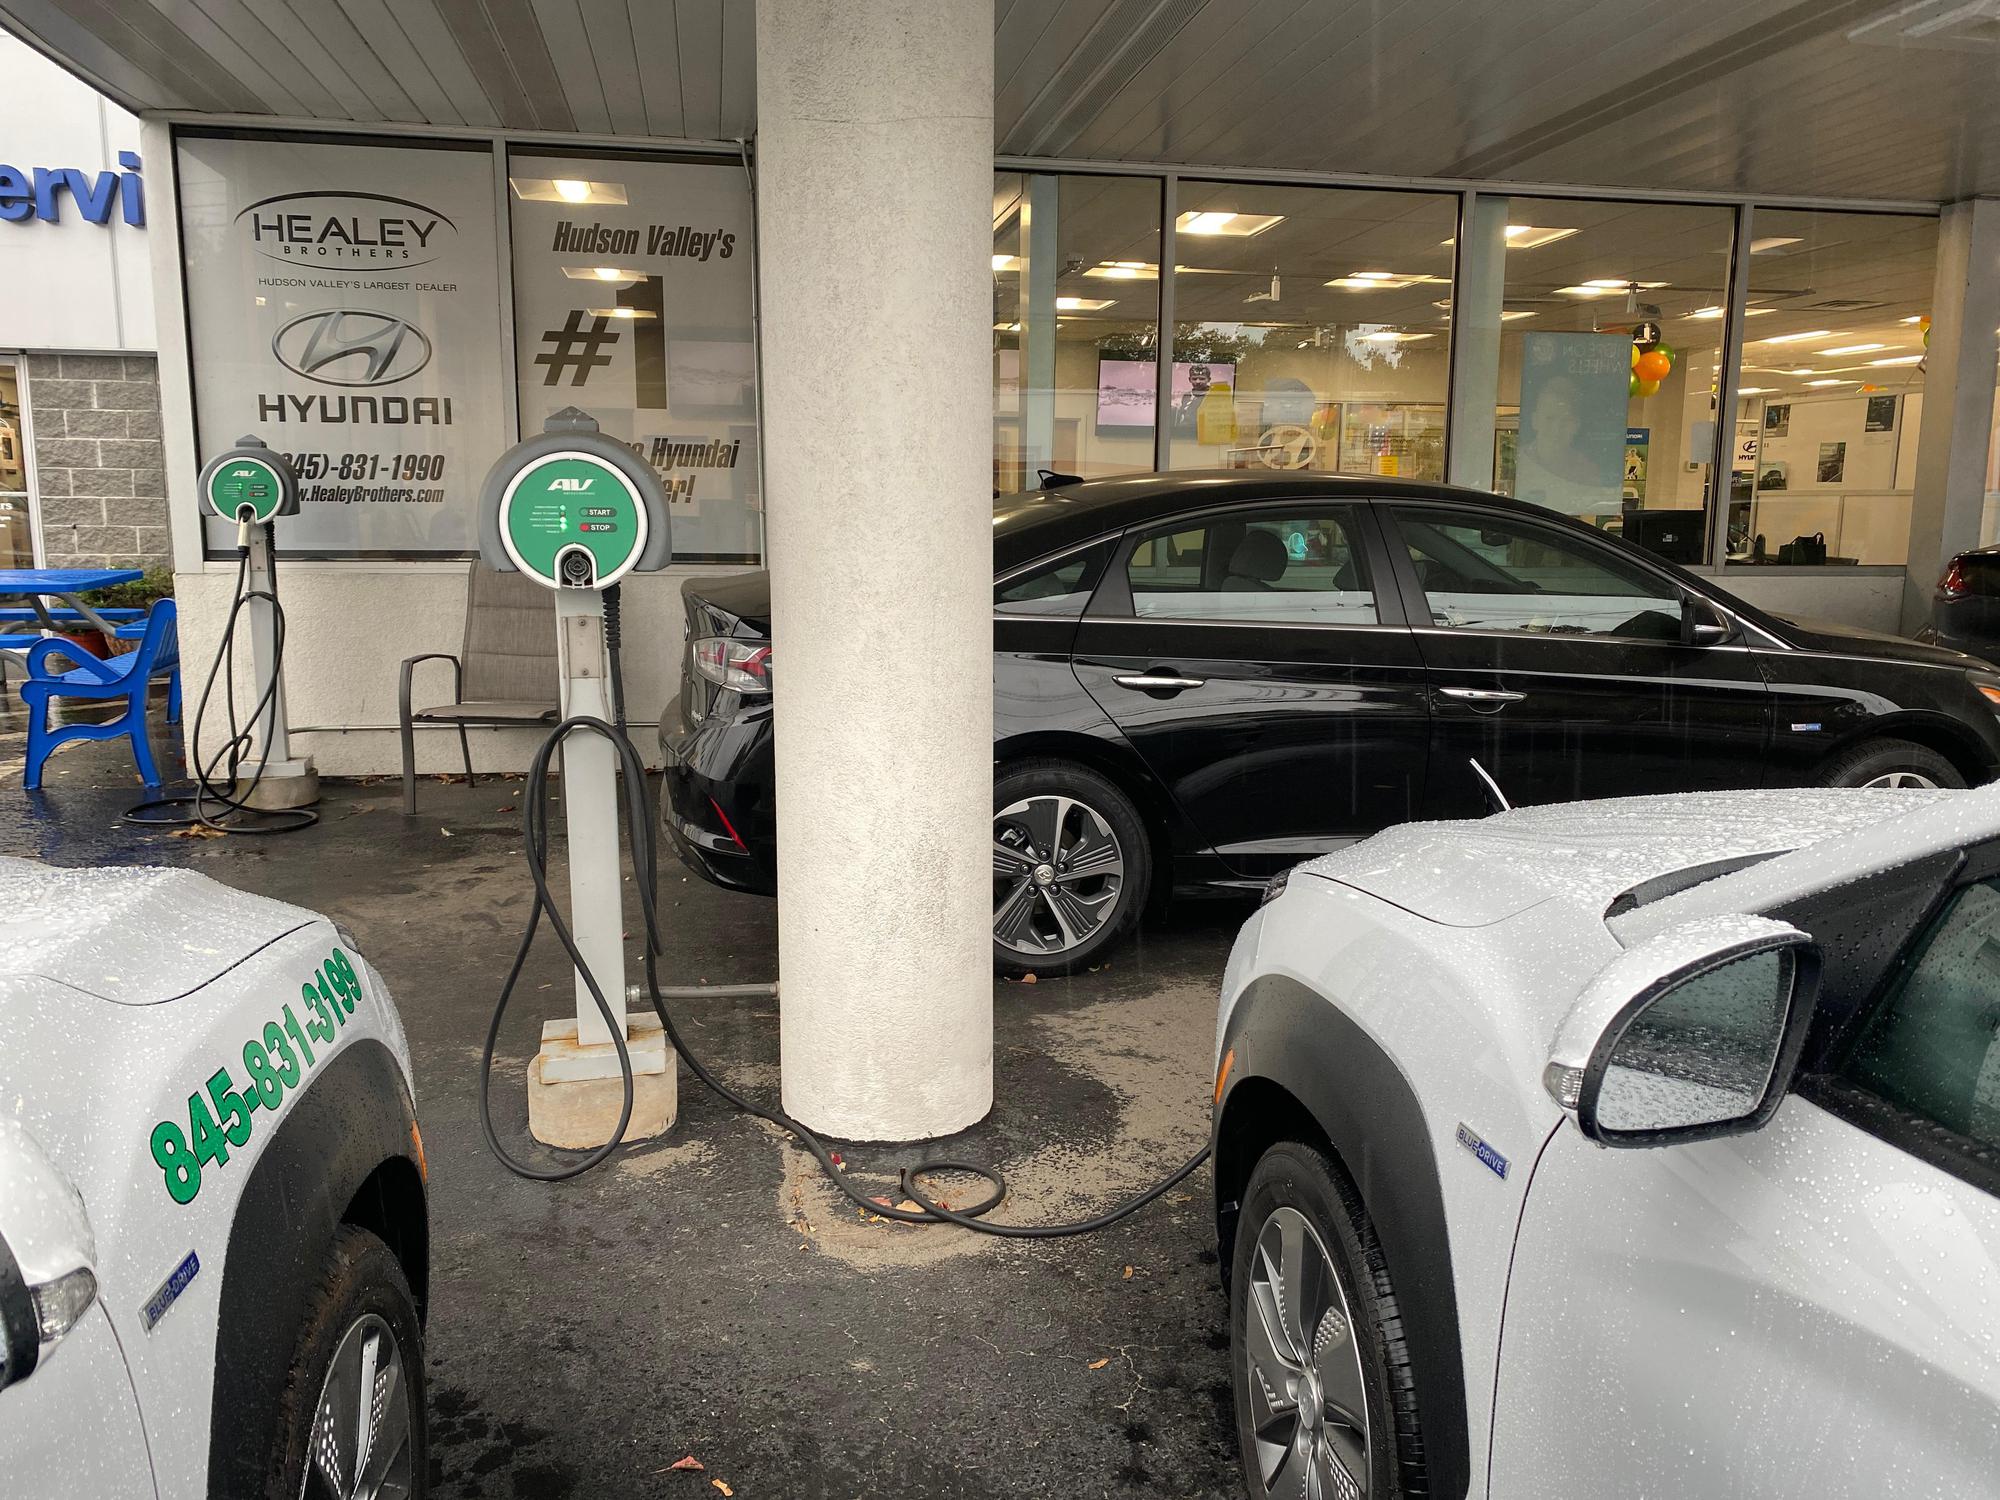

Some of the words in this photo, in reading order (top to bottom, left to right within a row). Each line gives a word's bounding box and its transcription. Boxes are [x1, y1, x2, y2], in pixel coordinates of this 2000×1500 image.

[253, 212, 437, 247] HEALEY
[552, 221, 639, 255] Hudson
[646, 225, 736, 262] Valley's
[284, 245, 409, 259] BROTHERS
[258, 278, 306, 288] HUDSON
[310, 279, 360, 289] VALLEY'S
[364, 281, 410, 291] LARGEST
[415, 283, 457, 292] DEALER
[534, 275, 667, 410] #1
[258, 394, 453, 425] HYUNDAI
[649, 438, 740, 471] Hyundai
[150, 948, 363, 1205] 845-831-3199
